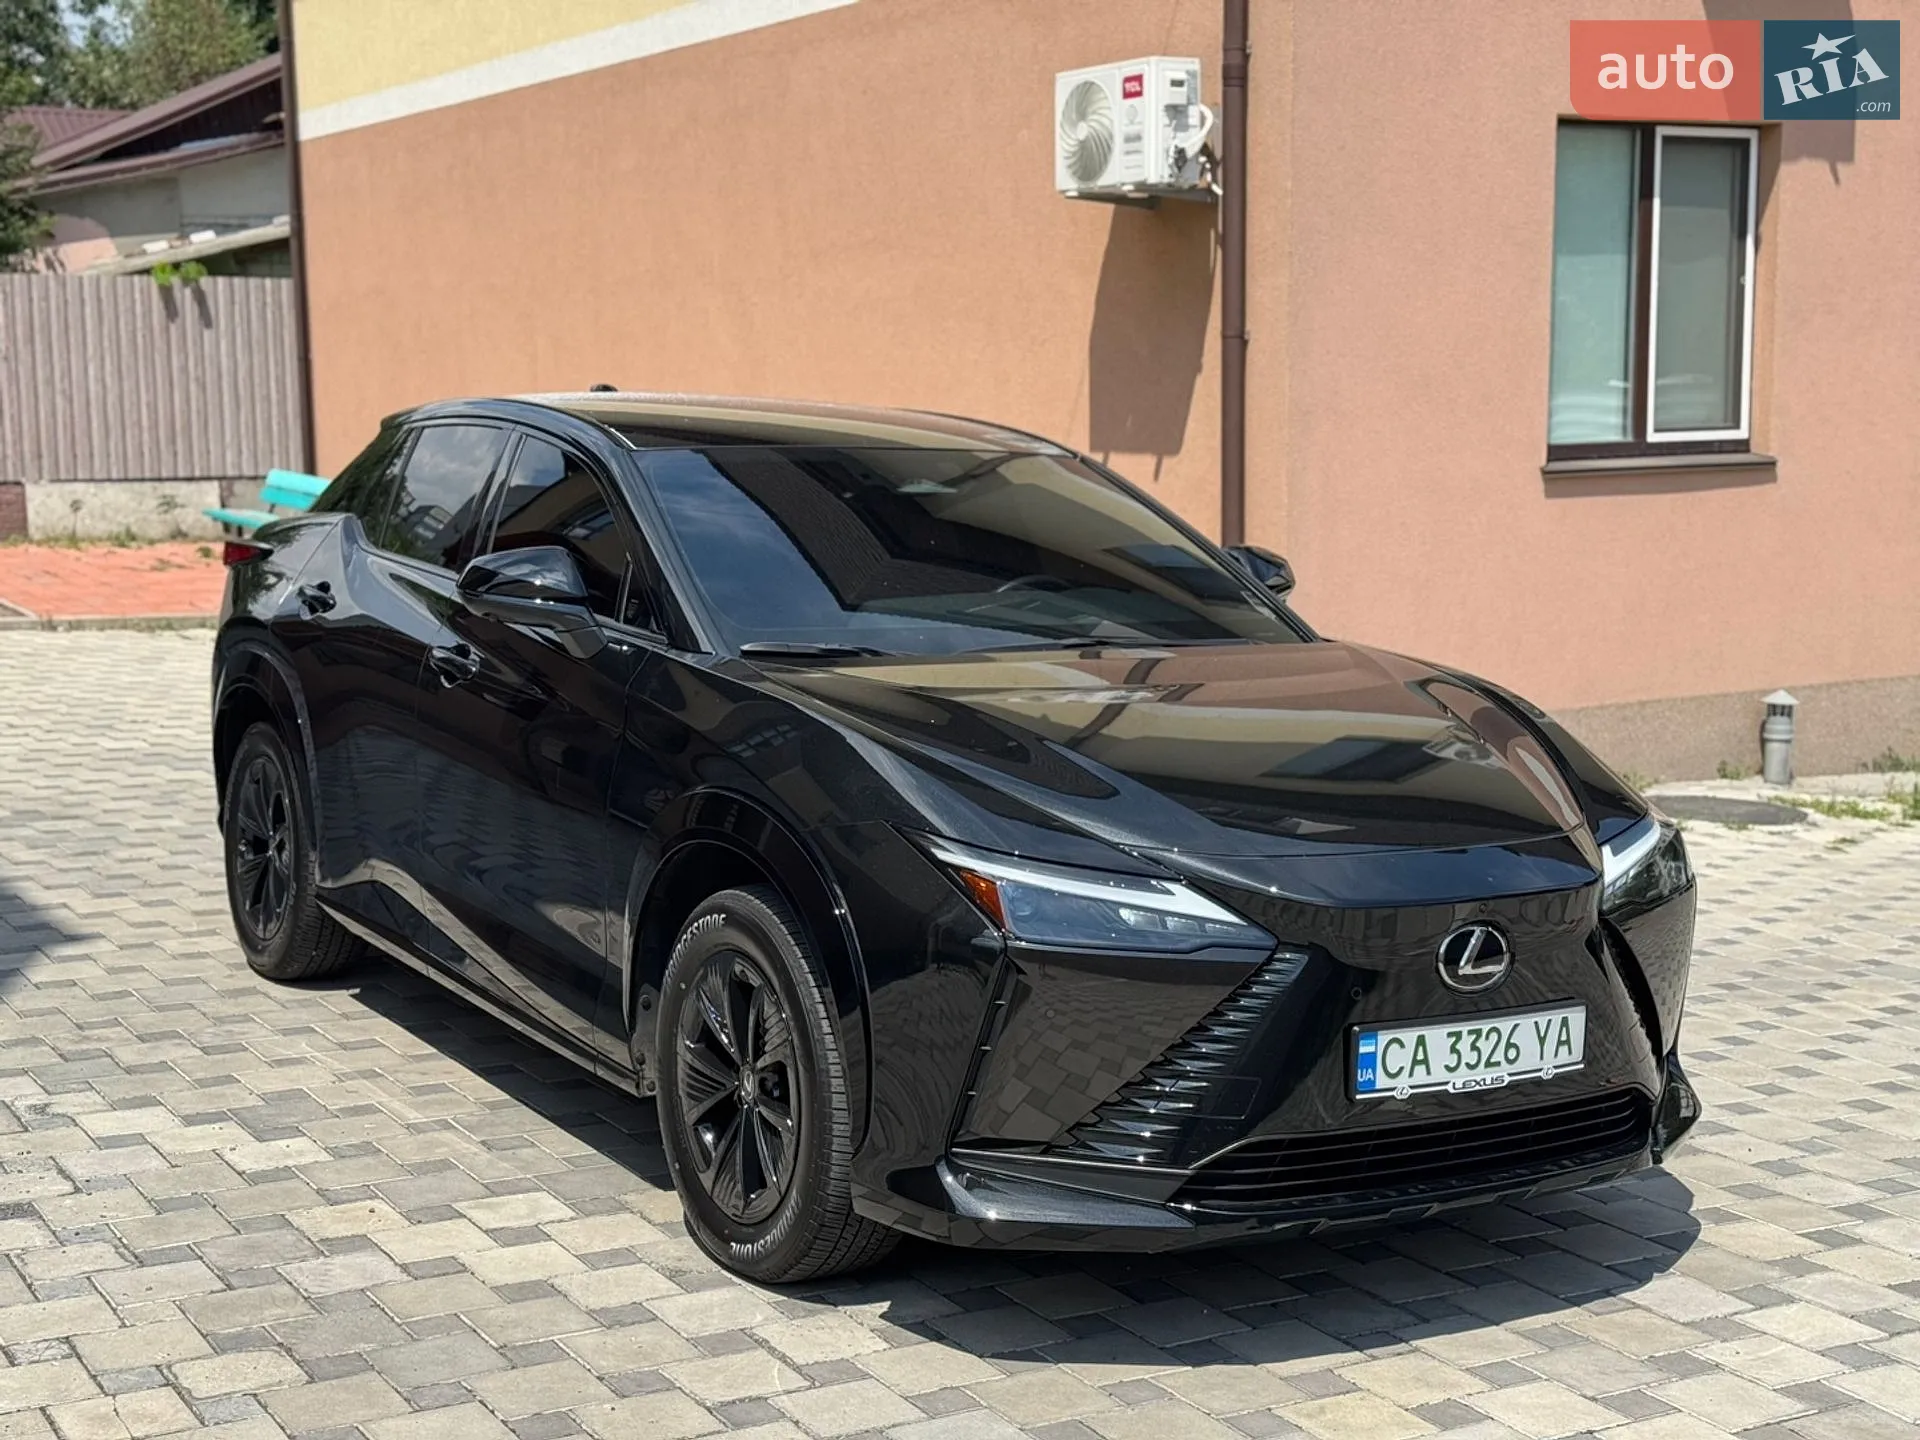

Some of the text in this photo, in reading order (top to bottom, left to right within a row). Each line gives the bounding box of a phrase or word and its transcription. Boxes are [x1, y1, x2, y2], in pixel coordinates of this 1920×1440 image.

[1381, 1016, 1574, 1080] CA 3326 YA
[1357, 1068, 1375, 1082] UA
[1452, 1076, 1506, 1091] LEXUS
